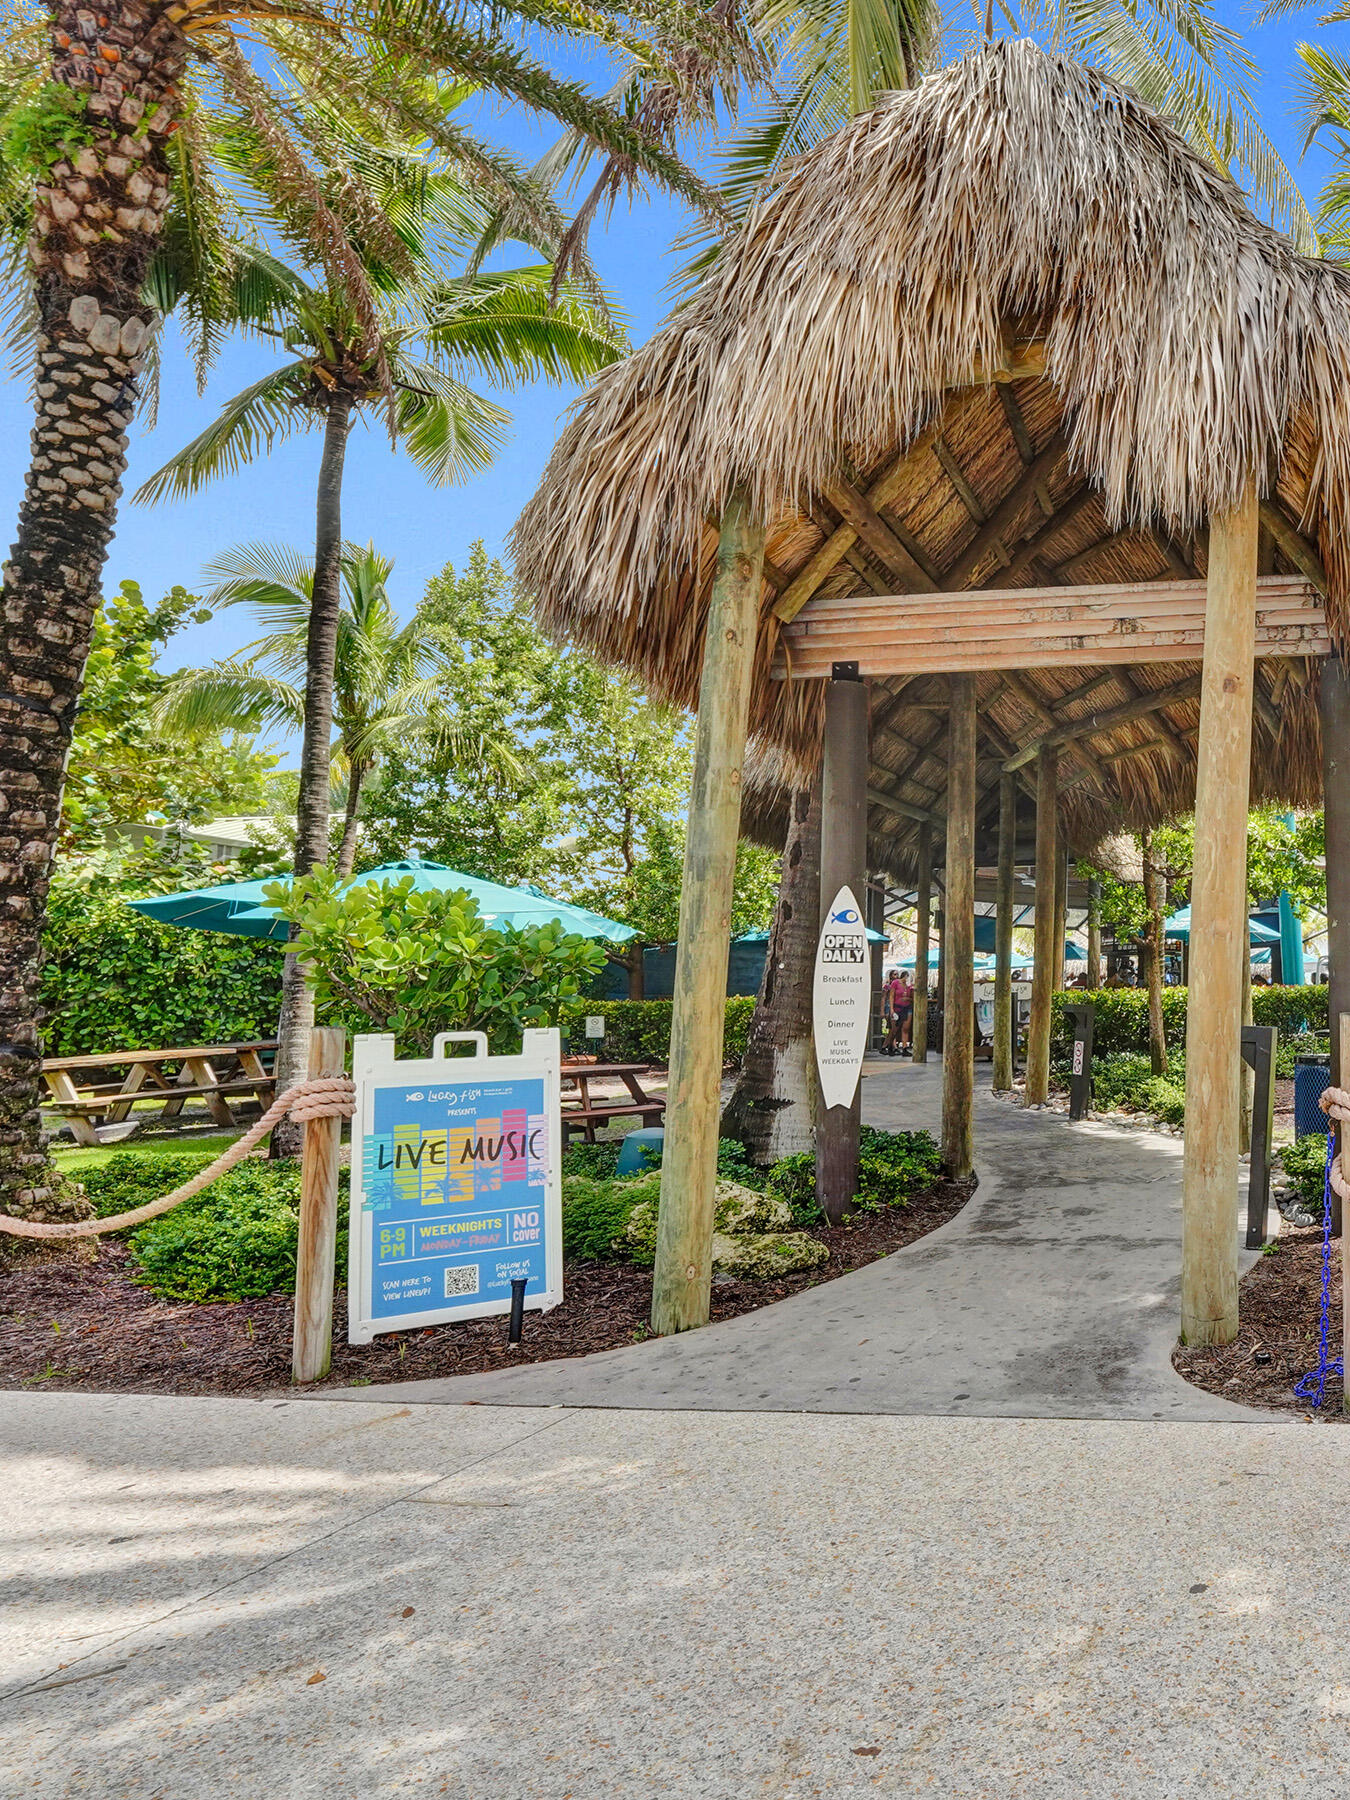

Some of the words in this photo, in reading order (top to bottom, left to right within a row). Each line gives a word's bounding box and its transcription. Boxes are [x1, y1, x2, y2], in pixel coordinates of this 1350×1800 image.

[825, 935, 863, 948] OPEN
[823, 949, 864, 963] DAILY
[822, 975, 863, 983] Breakfast
[829, 998, 855, 1006] Lunch
[828, 1020, 855, 1028] Dinner
[447, 1107, 477, 1117] PRESENTS
[378, 1139, 447, 1170] LIVE
[460, 1129, 542, 1164] MUSIC
[514, 1211, 539, 1228] NO
[419, 1219, 502, 1237] WEEKNIGHTS
[380, 1228, 406, 1243] 6-9
[513, 1228, 540, 1242] cover
[380, 1243, 406, 1259] PM
[495, 1262, 520, 1272] FOLLOW
[522, 1259, 531, 1267] US
[509, 1268, 529, 1278] SOCIAL
[383, 1279, 399, 1290] SCAN
[402, 1279, 420, 1287] HERE
[383, 1292, 401, 1301] VIEW
[403, 1287, 431, 1299] LINEUP!
